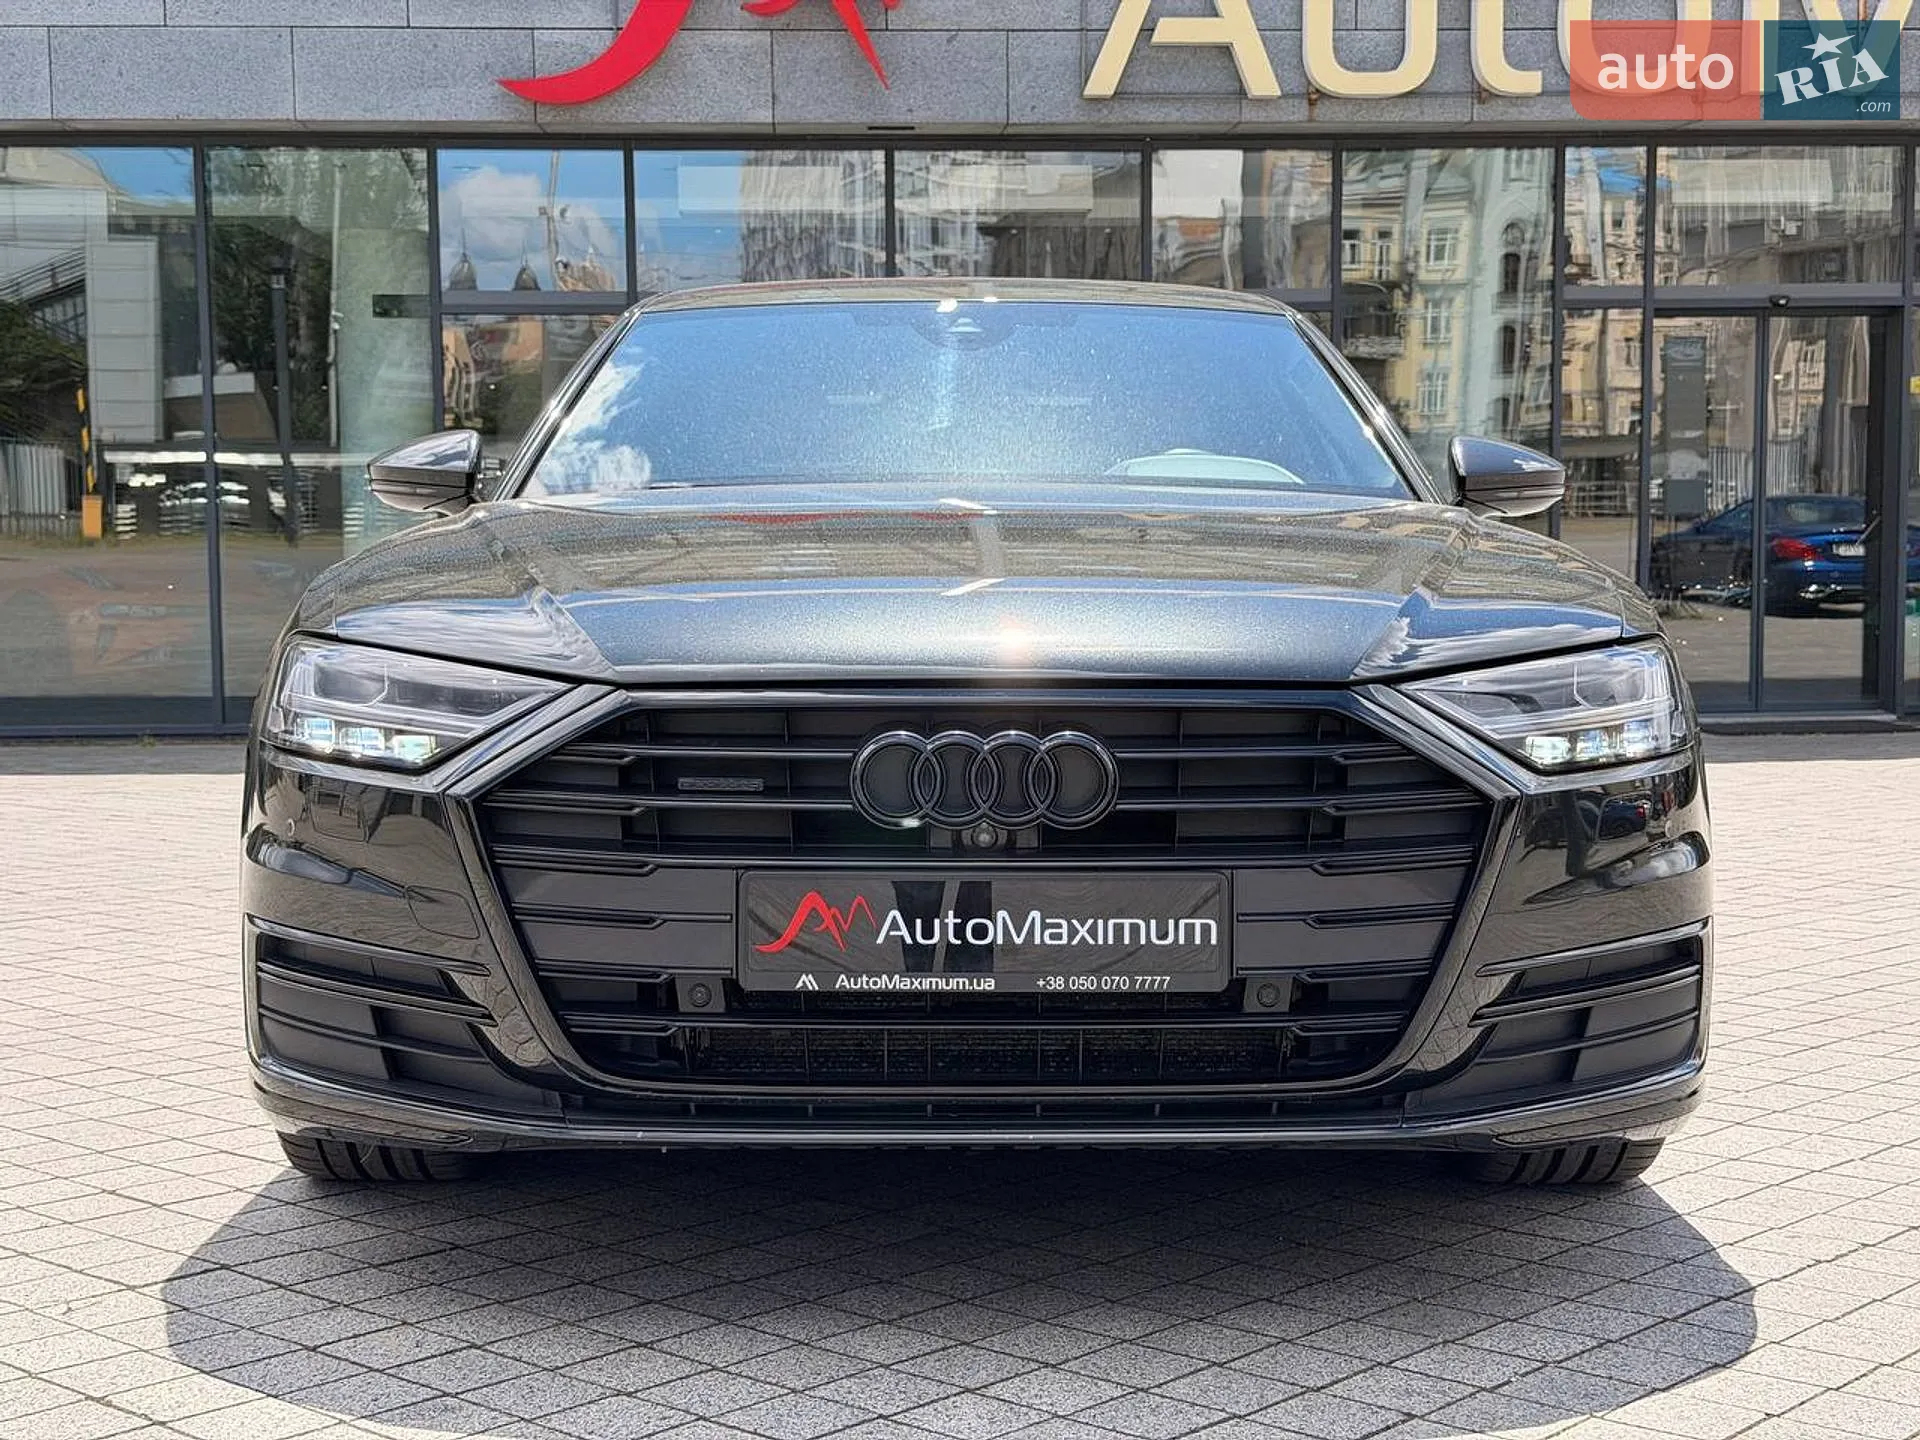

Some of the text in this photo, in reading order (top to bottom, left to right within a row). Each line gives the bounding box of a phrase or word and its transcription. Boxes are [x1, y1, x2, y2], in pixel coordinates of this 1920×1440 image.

[876, 909, 1218, 945] AutoMaximum
[835, 973, 996, 991] AutoMaximum.ua
[1036, 976, 1171, 990] +38 050 070 7777
